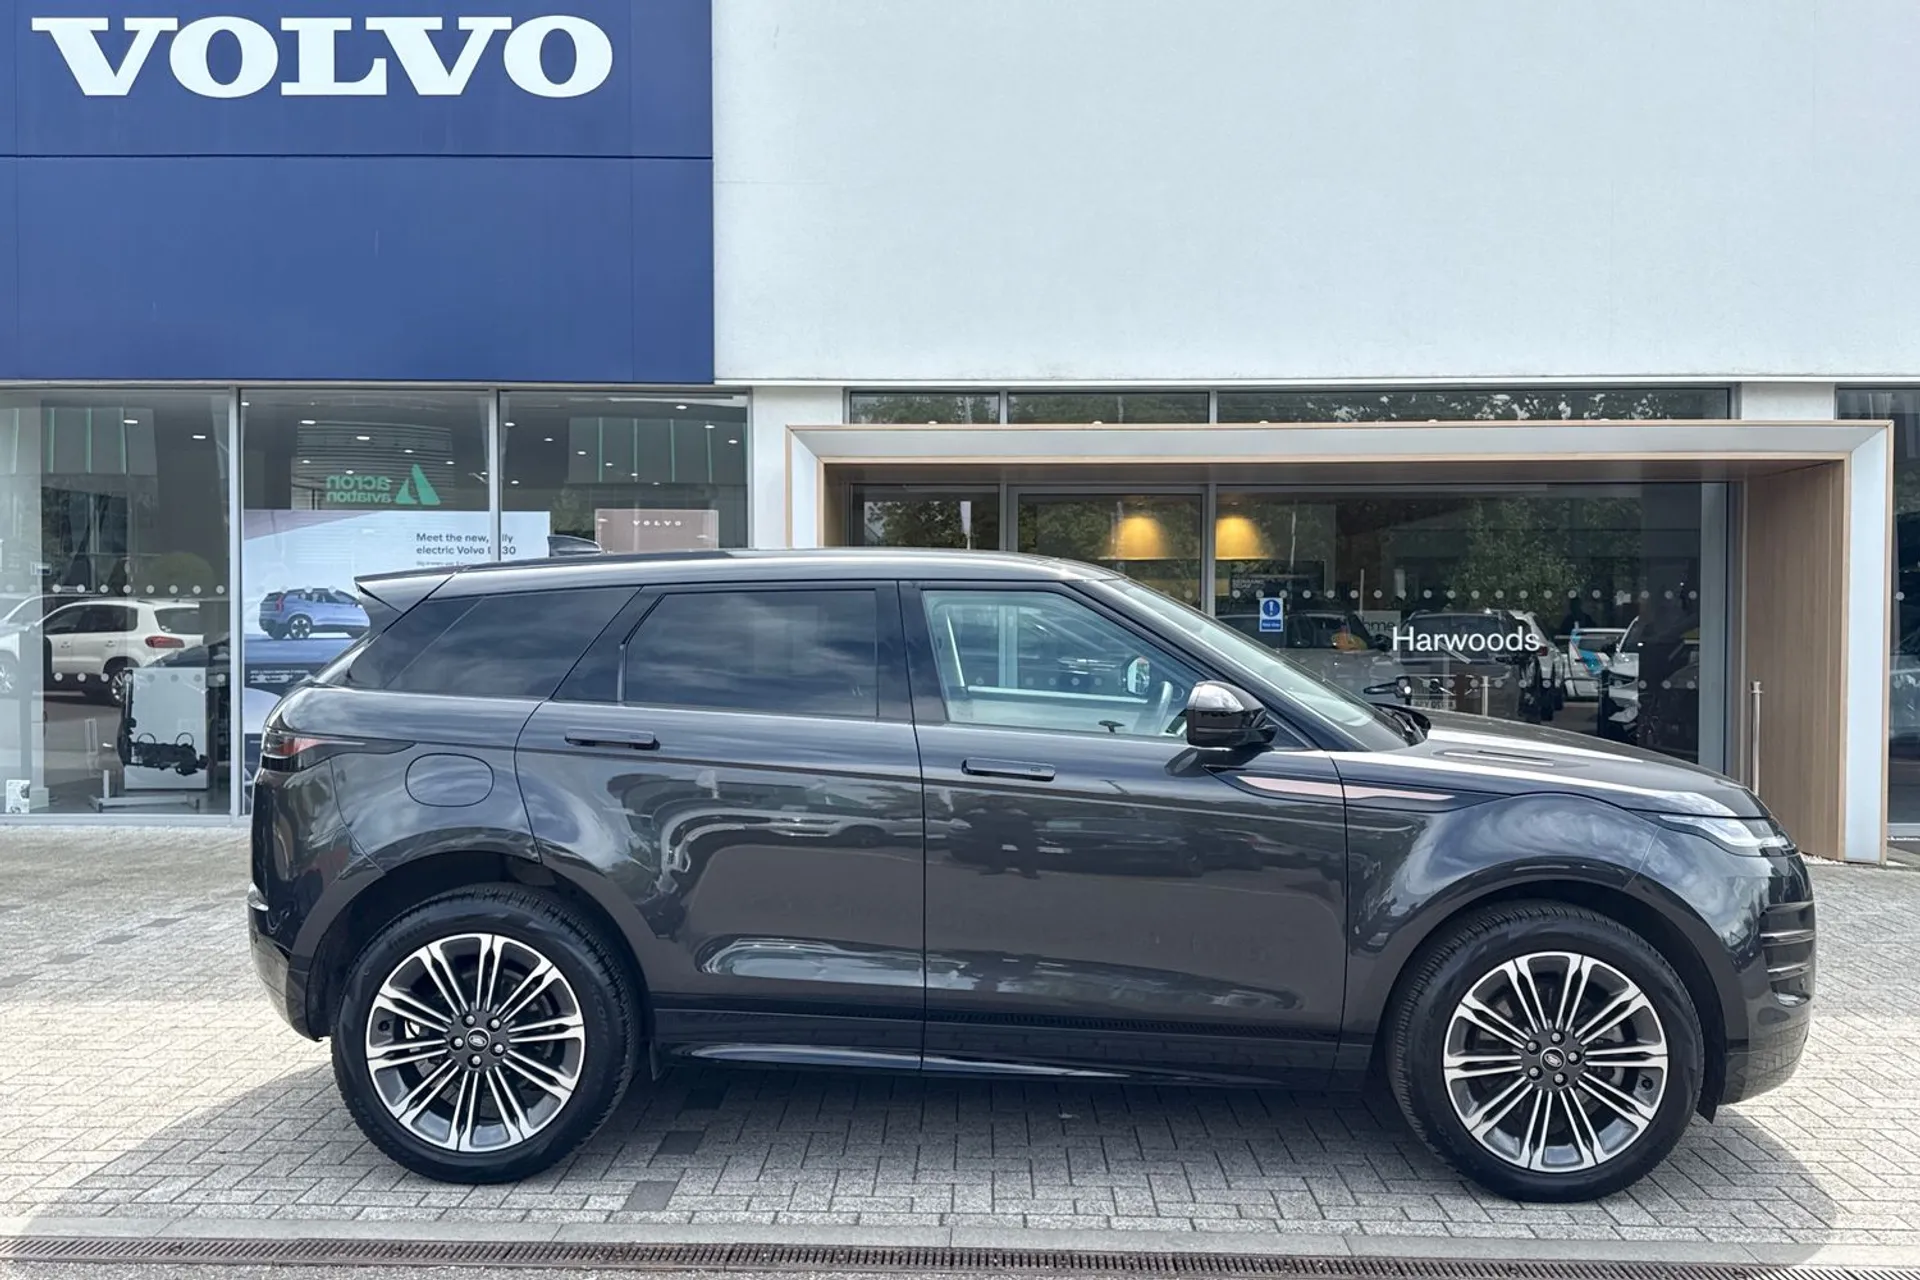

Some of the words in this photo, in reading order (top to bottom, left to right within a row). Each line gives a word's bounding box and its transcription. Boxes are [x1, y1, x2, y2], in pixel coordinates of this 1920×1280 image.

[31, 15, 613, 98] VOLVO
[416, 533, 443, 542] Meet
[445, 533, 462, 542] the
[465, 535, 489, 544] new,
[416, 546, 454, 555] electric
[457, 546, 485, 555] Volvo
[488, 546, 516, 555] E30
[1393, 626, 1540, 652] Harwoods
